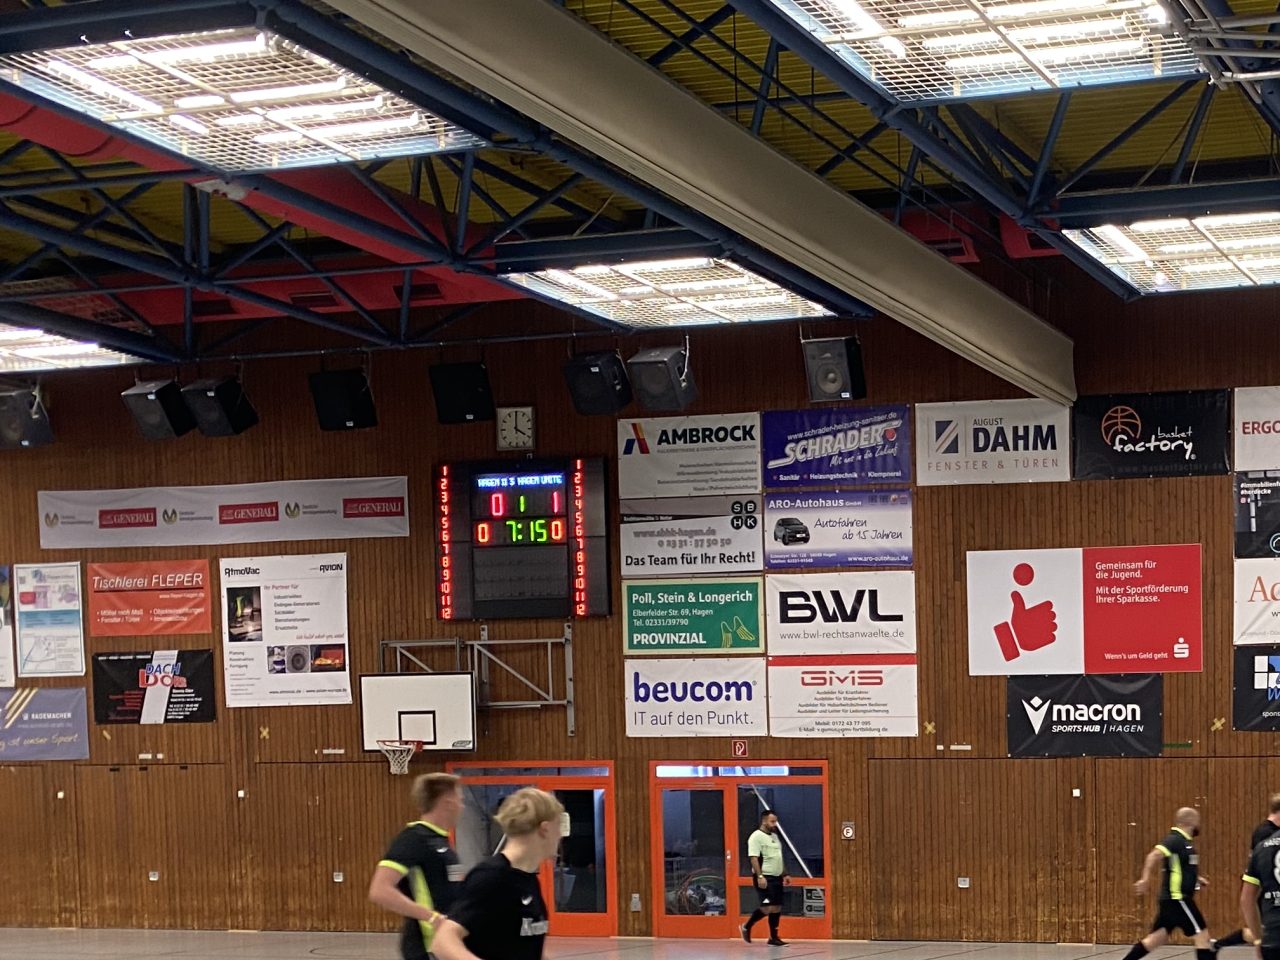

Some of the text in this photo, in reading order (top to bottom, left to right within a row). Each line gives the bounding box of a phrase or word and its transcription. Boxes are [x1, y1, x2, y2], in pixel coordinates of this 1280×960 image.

[973, 418, 1004, 426] AUGUST
[657, 425, 756, 445] AMBROCK
[1158, 426, 1192, 438] basket
[784, 423, 885, 462] SCHRADER
[973, 425, 1057, 453] DAHM
[1113, 434, 1193, 460] factory
[577, 459, 582, 470] 1
[928, 458, 1059, 471] FENSTER & TÜREN
[442, 465, 448, 477] 1
[441, 478, 448, 489] 2
[574, 472, 581, 484] 2
[442, 491, 448, 502] 3
[575, 486, 581, 497] 3
[359, 502, 401, 513] GENERALI
[491, 493, 503, 516] 0
[575, 498, 581, 510] 4
[768, 498, 844, 509] ARO-Autohaus
[235, 506, 276, 519] GENERALI
[441, 505, 448, 515] 4
[114, 512, 154, 523] GENERALI
[441, 518, 449, 529] 5
[575, 512, 582, 524] 5
[813, 518, 867, 528] Autofahren
[442, 530, 449, 541] 6
[477, 523, 489, 542] 0
[506, 520, 547, 542] 7:15
[551, 520, 562, 540] 0
[575, 525, 582, 536] 6
[842, 529, 903, 540] ab 15 Jahren
[442, 543, 448, 554] 7
[576, 538, 584, 549] 7
[442, 556, 449, 568] 8
[576, 551, 584, 563] 8
[625, 551, 755, 566] Das Team für Ihr Recht!
[320, 564, 343, 573] AVION
[577, 564, 584, 576] 9
[1095, 560, 1157, 570] Gemeinsam für
[225, 567, 260, 577] AtmoVac
[442, 569, 450, 581] 9
[1095, 570, 1143, 580] die Jugend.
[92, 573, 203, 589] Tischlerei FLEPER
[575, 578, 585, 589] 10
[441, 582, 450, 594] 10
[1096, 584, 1189, 596] Mit der Sportförderung
[441, 595, 450, 606] 11
[575, 591, 585, 601] 11
[632, 590, 753, 605] Poll, Stein & Longerich
[1096, 594, 1160, 605] Ihrer Sparkasse.
[576, 604, 585, 615] 12
[779, 589, 903, 623] BWL
[442, 608, 450, 619] 12
[632, 608, 713, 618] Elberfelder Str. 69, Hagen
[633, 618, 689, 627] Tel. 02331/39790
[633, 633, 707, 645] PROVINZIAL
[780, 629, 905, 640] www.bwl-rechtsanwaelte.de
[146, 662, 181, 675] DACH
[801, 670, 884, 686] GMS
[633, 671, 753, 702] beucom
[634, 710, 754, 725] IT auf den Punkt.
[1052, 703, 1141, 722] macron
[1051, 725, 1082, 733] SPORTS
[1109, 725, 1144, 733] HAGEN
